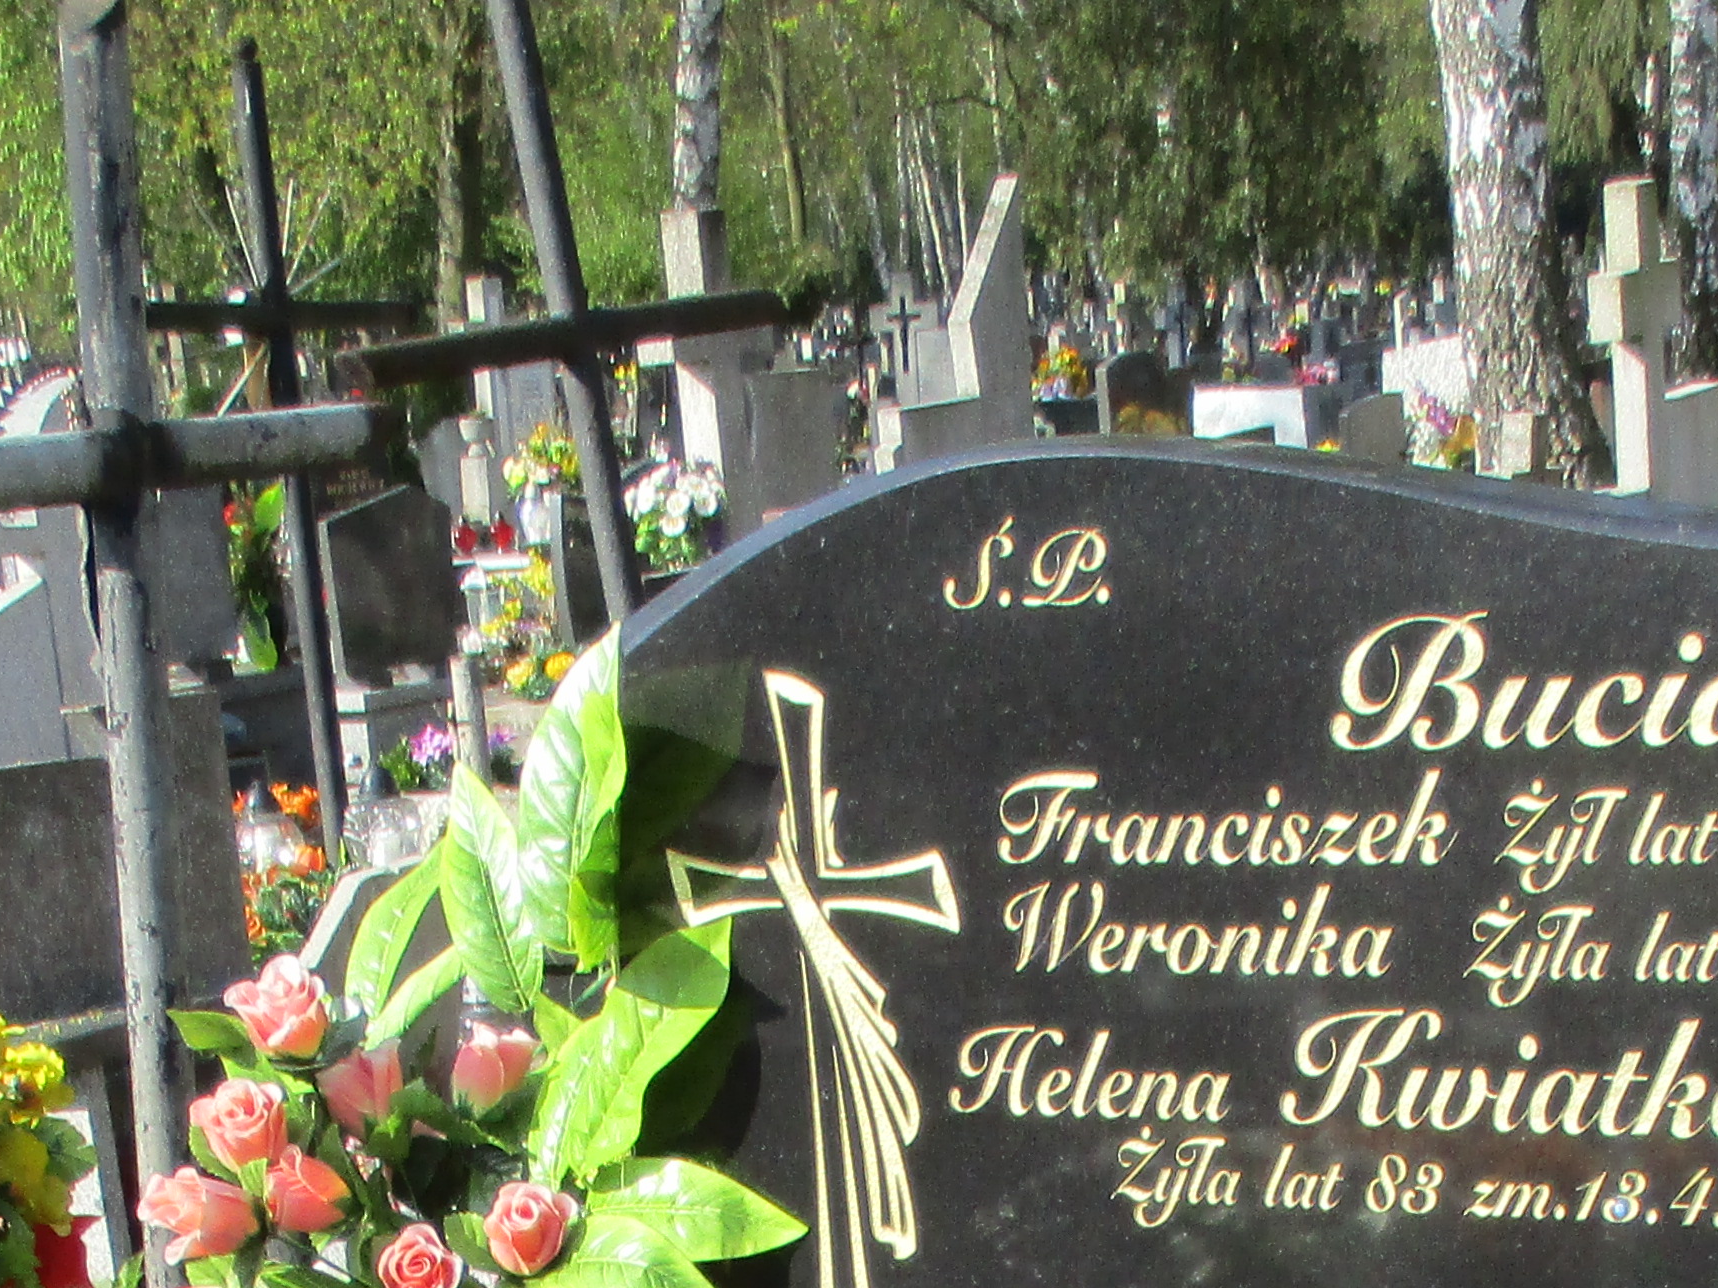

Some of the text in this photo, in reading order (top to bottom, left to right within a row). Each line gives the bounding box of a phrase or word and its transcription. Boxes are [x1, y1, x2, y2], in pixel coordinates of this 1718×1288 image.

[996, 768, 1458, 866] Franciszek
[1002, 881, 1393, 977] Weronika
[948, 1025, 1231, 1122] Helena
[1263, 1143, 1345, 1211] lat
[1363, 1153, 1445, 1214] 83
